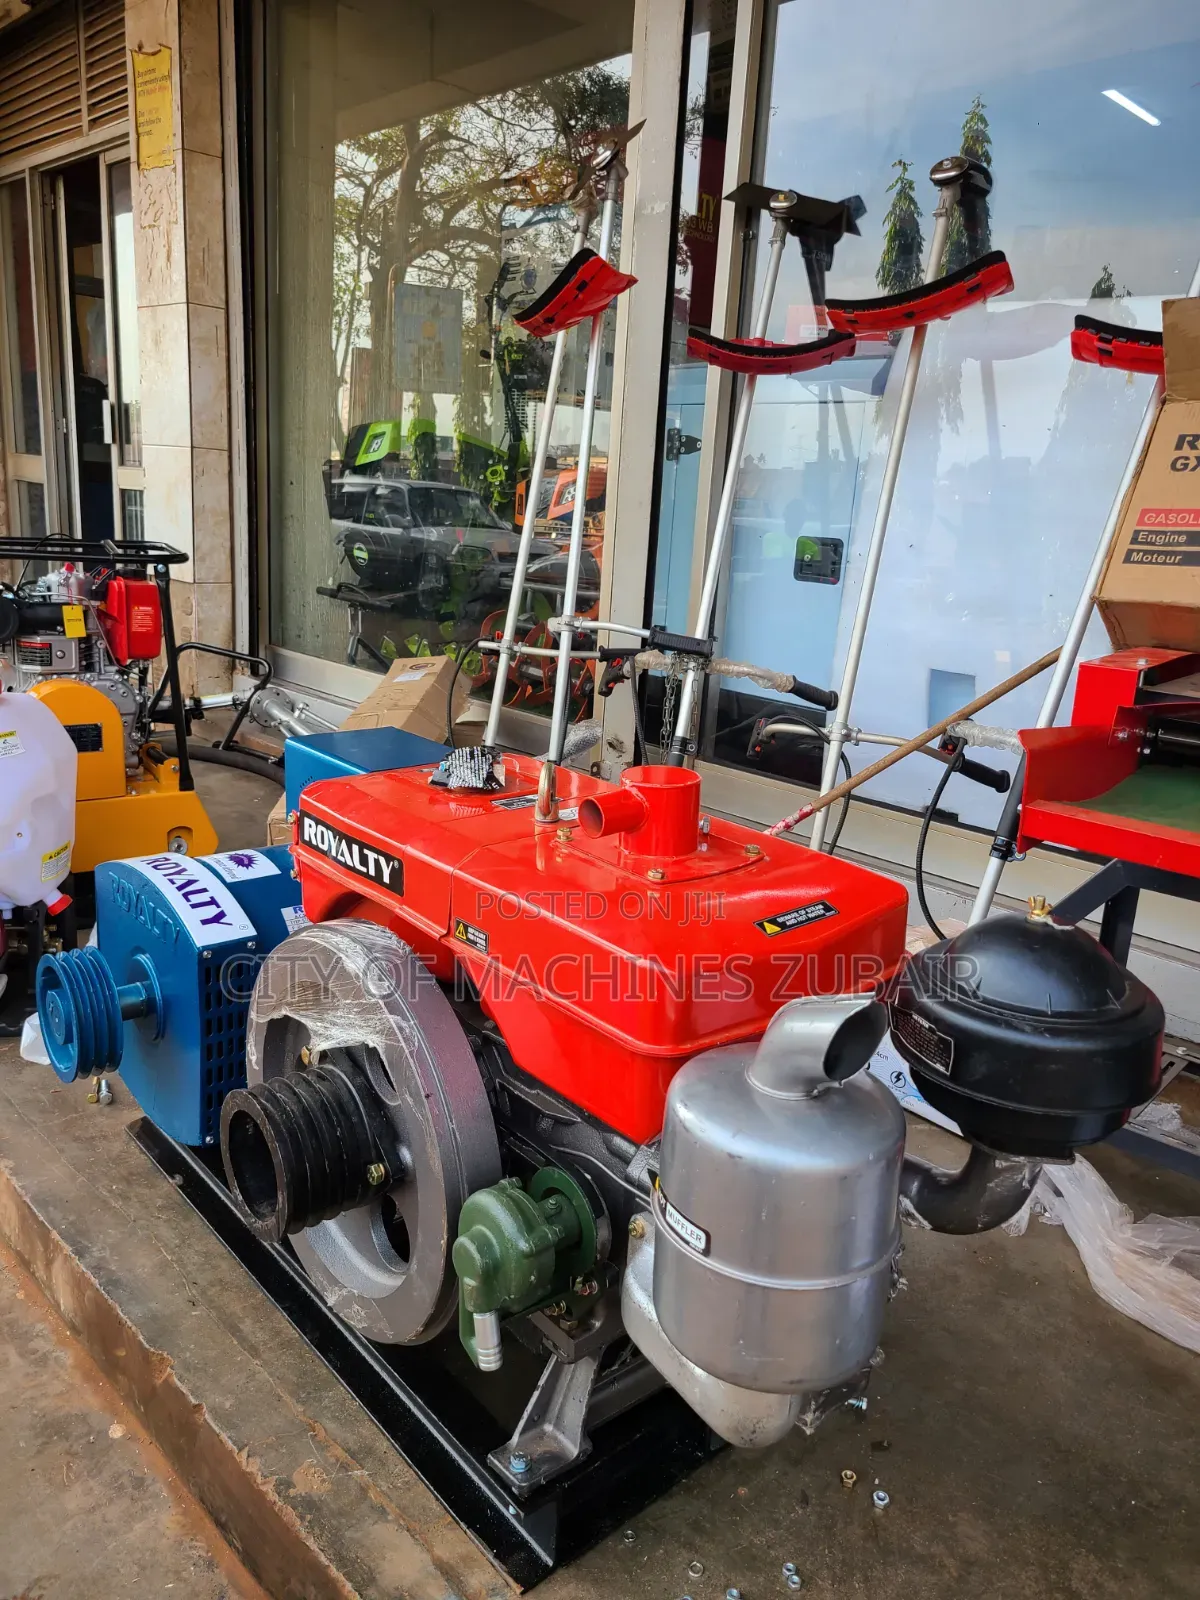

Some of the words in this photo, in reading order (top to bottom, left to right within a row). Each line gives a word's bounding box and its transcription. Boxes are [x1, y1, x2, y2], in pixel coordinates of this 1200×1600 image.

[1138, 532, 1187, 545] Engine
[1130, 552, 1182, 564] Moteur
[139, 856, 233, 926] ROYALTY
[108, 871, 180, 944] ROYALTY
[776, 912, 800, 923] BEWARE
[805, 904, 824, 913] STEAM
[786, 918, 797, 926] AND
[796, 914, 808, 922] HOT
[807, 909, 825, 918] WATER
[667, 1209, 702, 1244] MUFFLER
